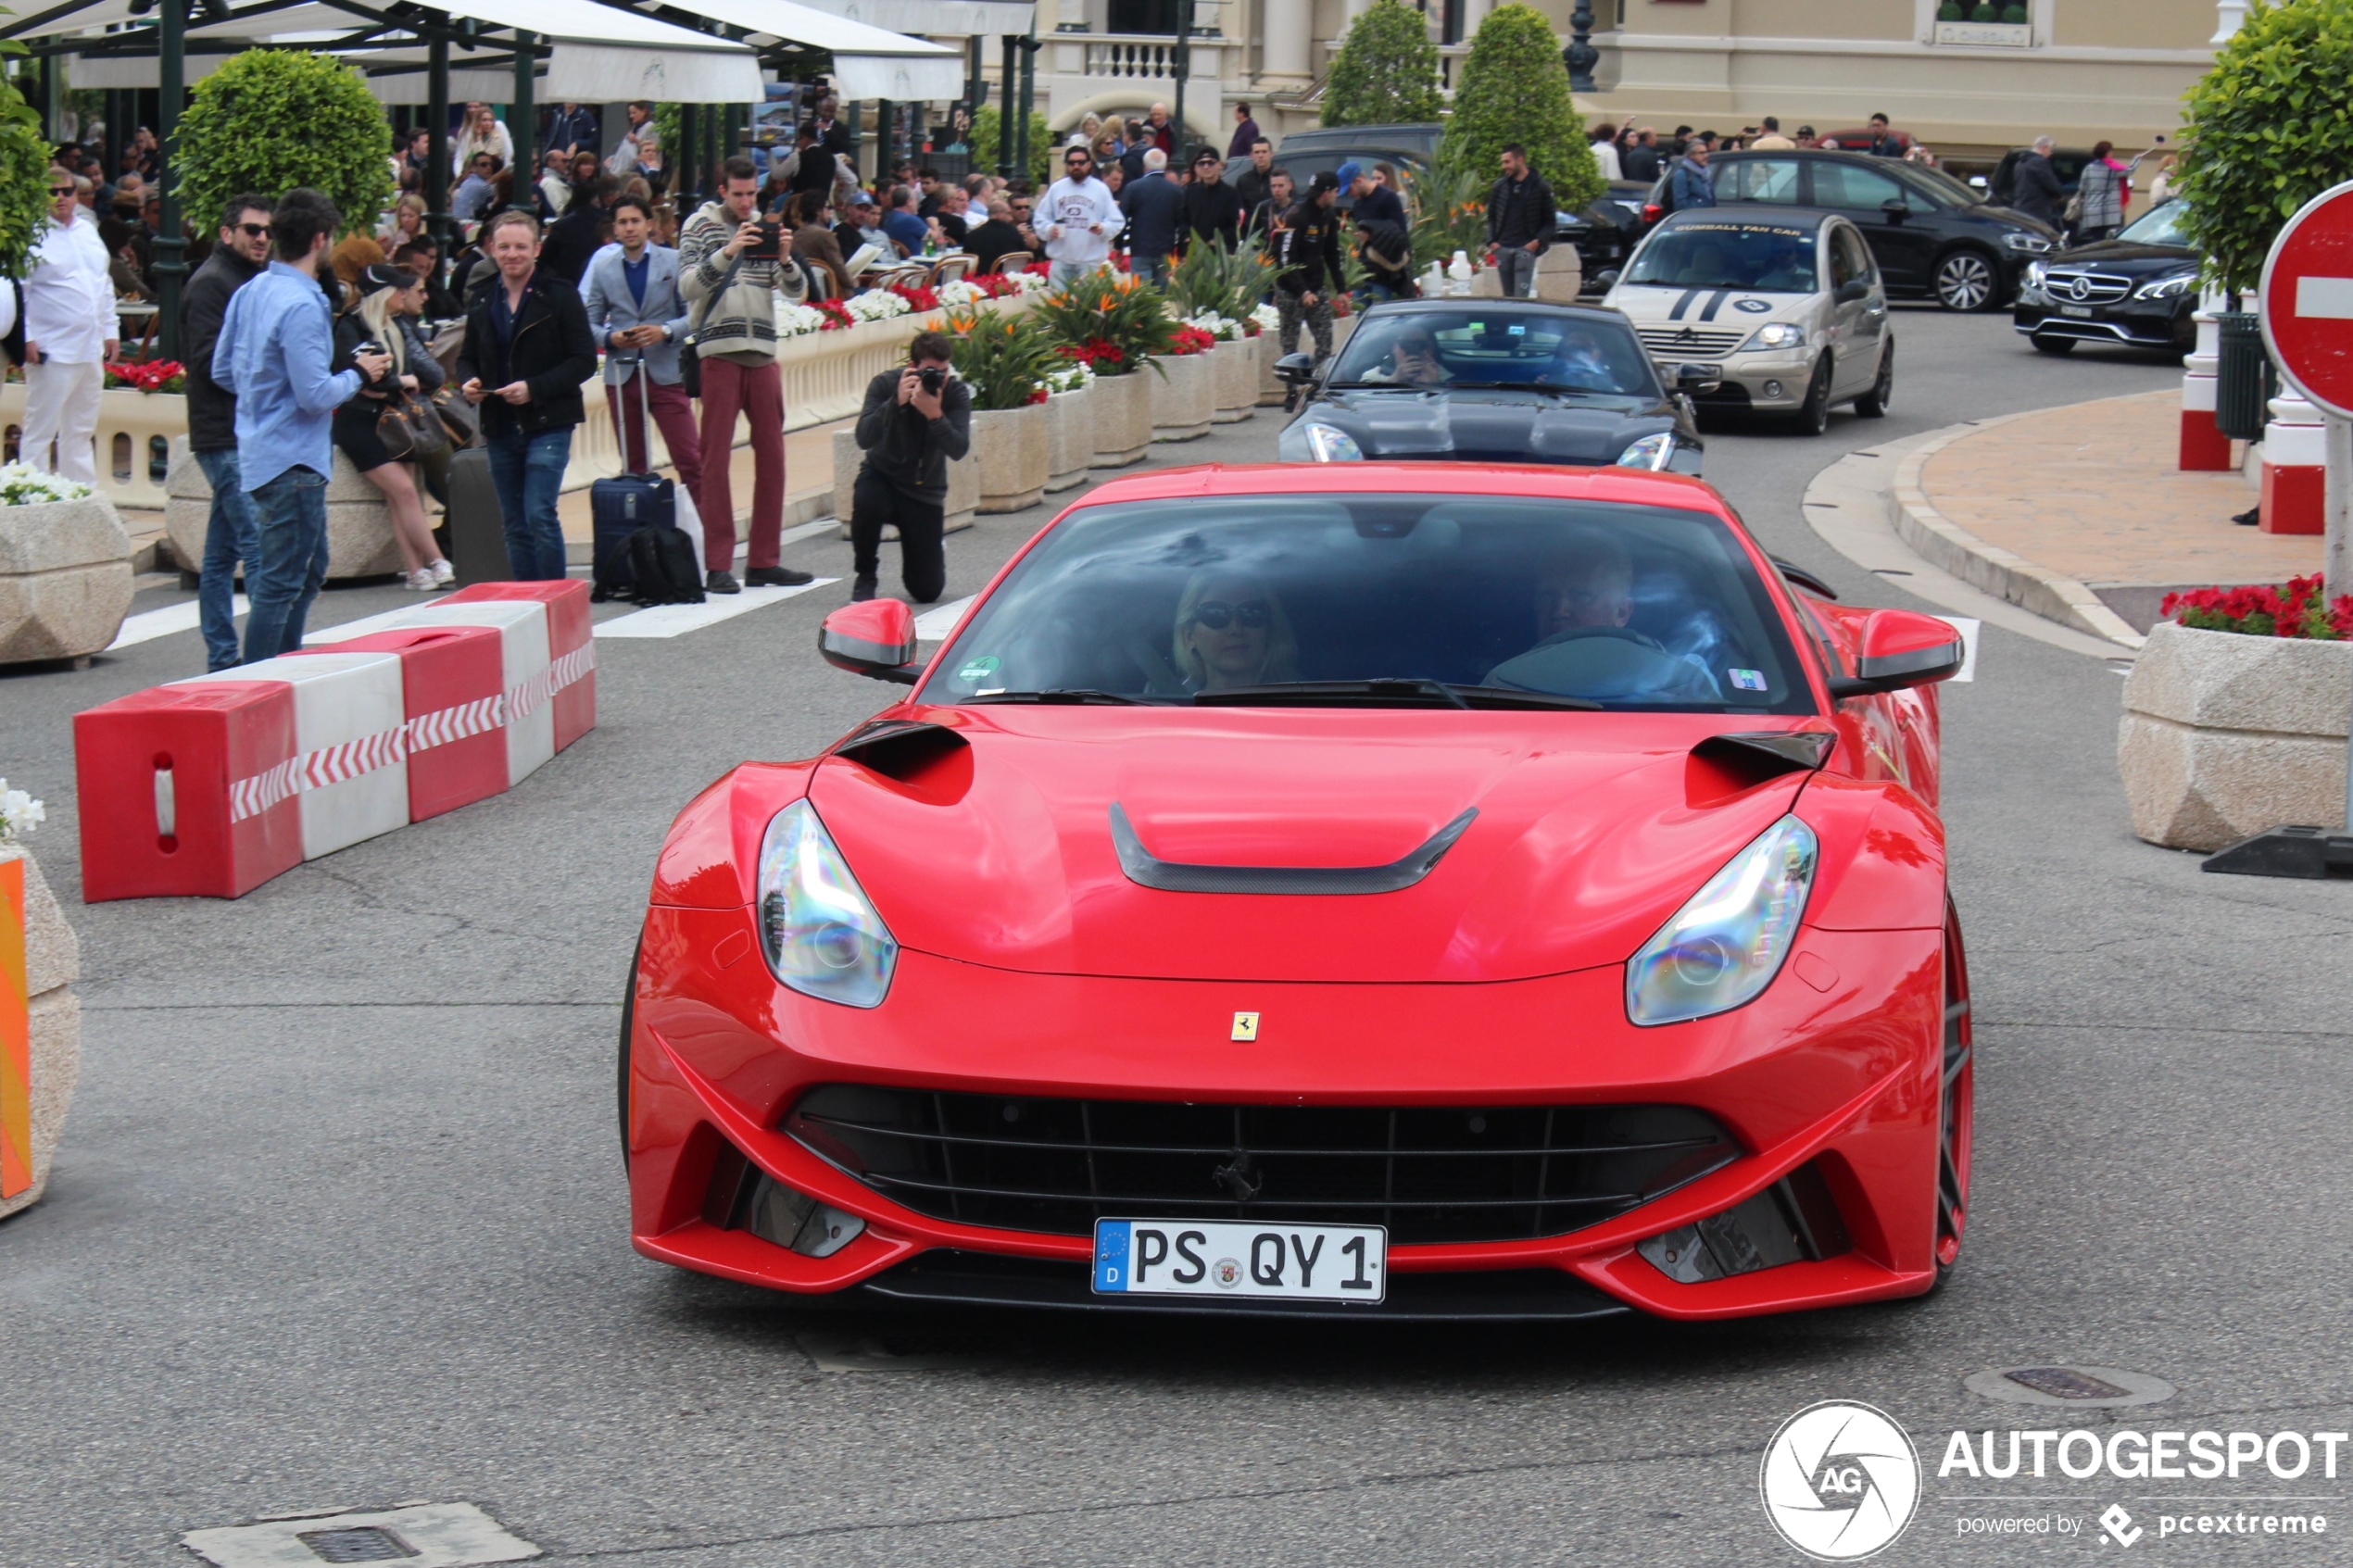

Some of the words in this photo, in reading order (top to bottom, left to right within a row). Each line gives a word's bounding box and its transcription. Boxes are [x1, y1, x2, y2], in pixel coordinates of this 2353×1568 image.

[1772, 227, 1802, 236] CAR
[1136, 1229, 1206, 1284] PS
[1251, 1233, 1325, 1287] QY
[1340, 1236, 1373, 1289] 1
[1106, 1267, 1118, 1283] D
